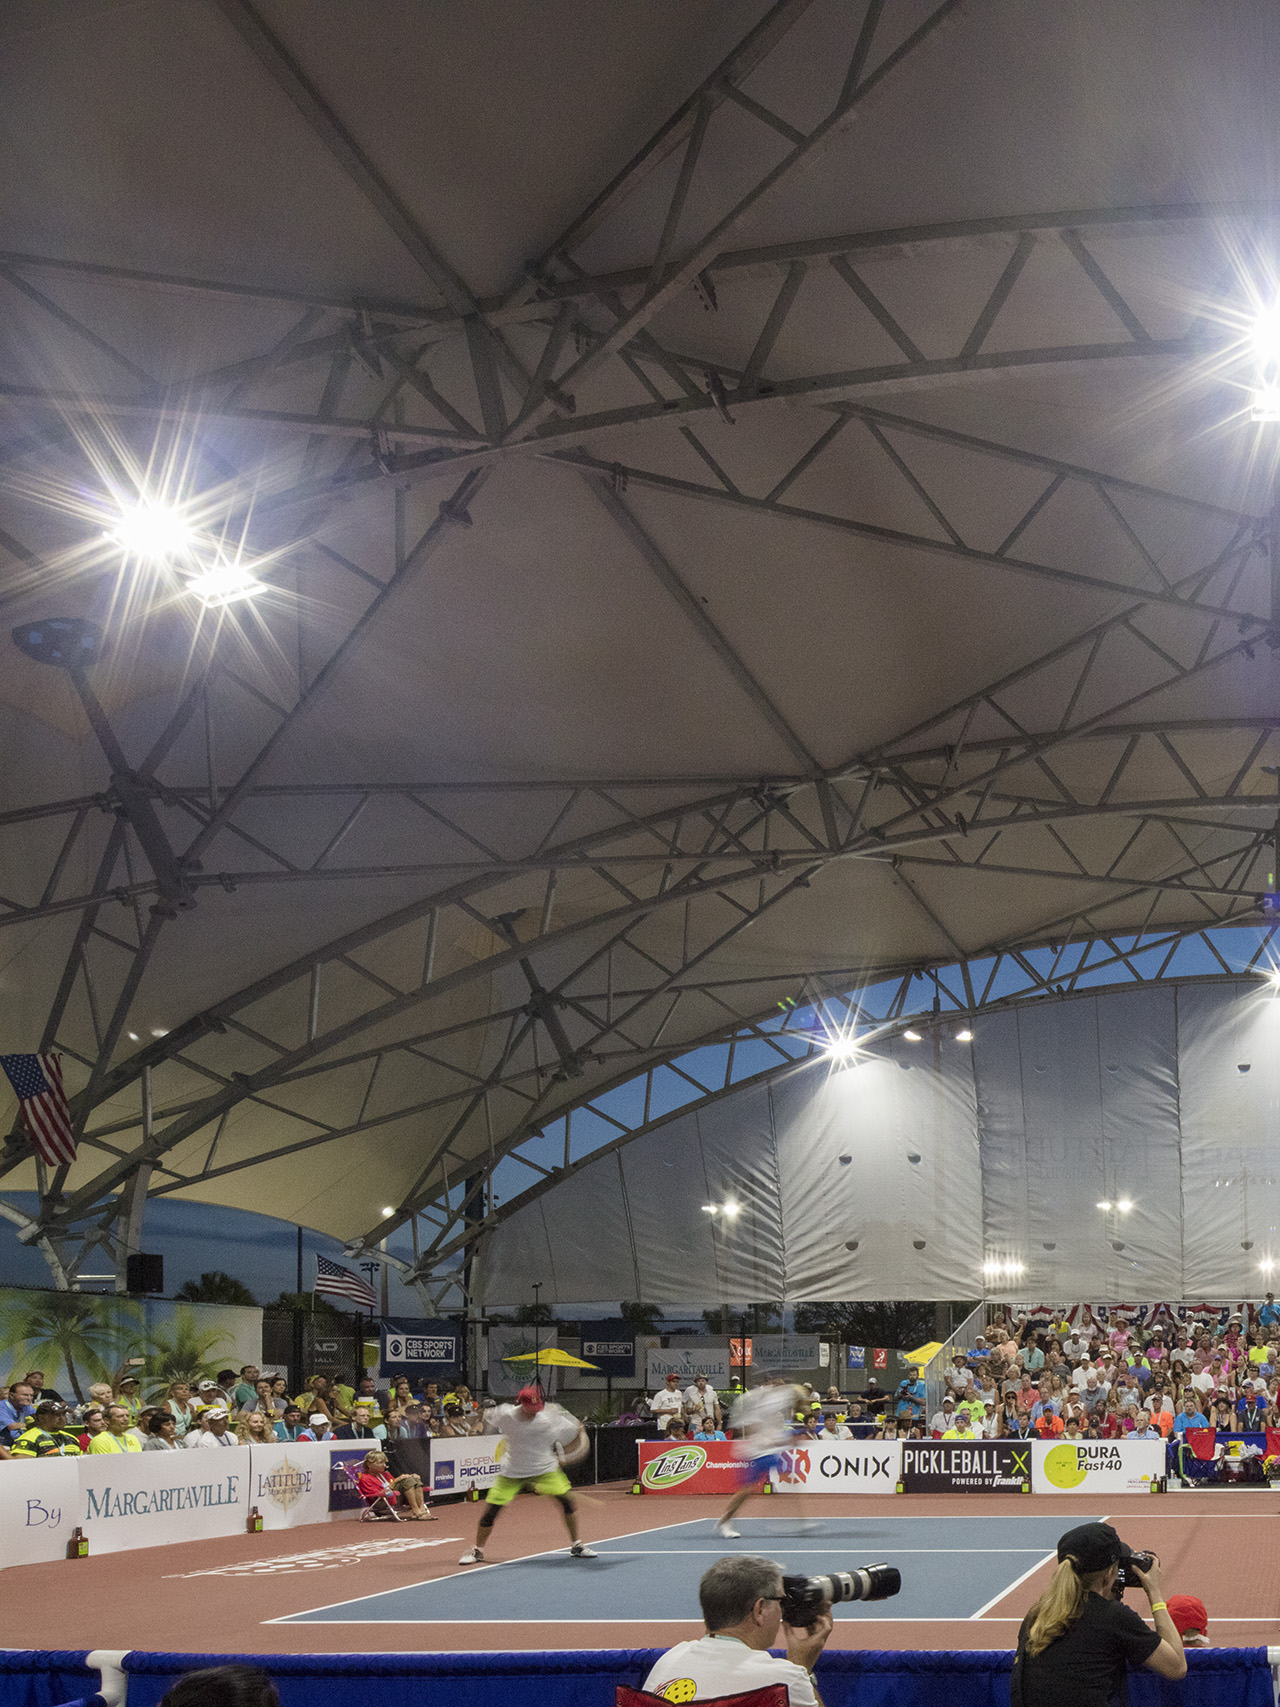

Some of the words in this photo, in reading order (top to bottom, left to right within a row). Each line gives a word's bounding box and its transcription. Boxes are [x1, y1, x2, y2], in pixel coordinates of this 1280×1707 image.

[406, 1340, 422, 1349] CBS
[423, 1340, 453, 1350] SPORTS
[406, 1349, 446, 1358] NETWORK
[1076, 1446, 1120, 1459] DURA
[459, 1458, 472, 1467] US
[819, 1454, 890, 1479] ONIX
[903, 1450, 1029, 1475] PICKLEBALL-X
[459, 1464, 502, 1478] PICKLEB
[257, 1470, 312, 1498] LATITUDE
[952, 1477, 983, 1486] POWERED
[984, 1477, 993, 1486] BY
[992, 1474, 1024, 1488] Frankli
[86, 1475, 239, 1520] MARGARITAVILLE
[25, 1498, 62, 1529] By
